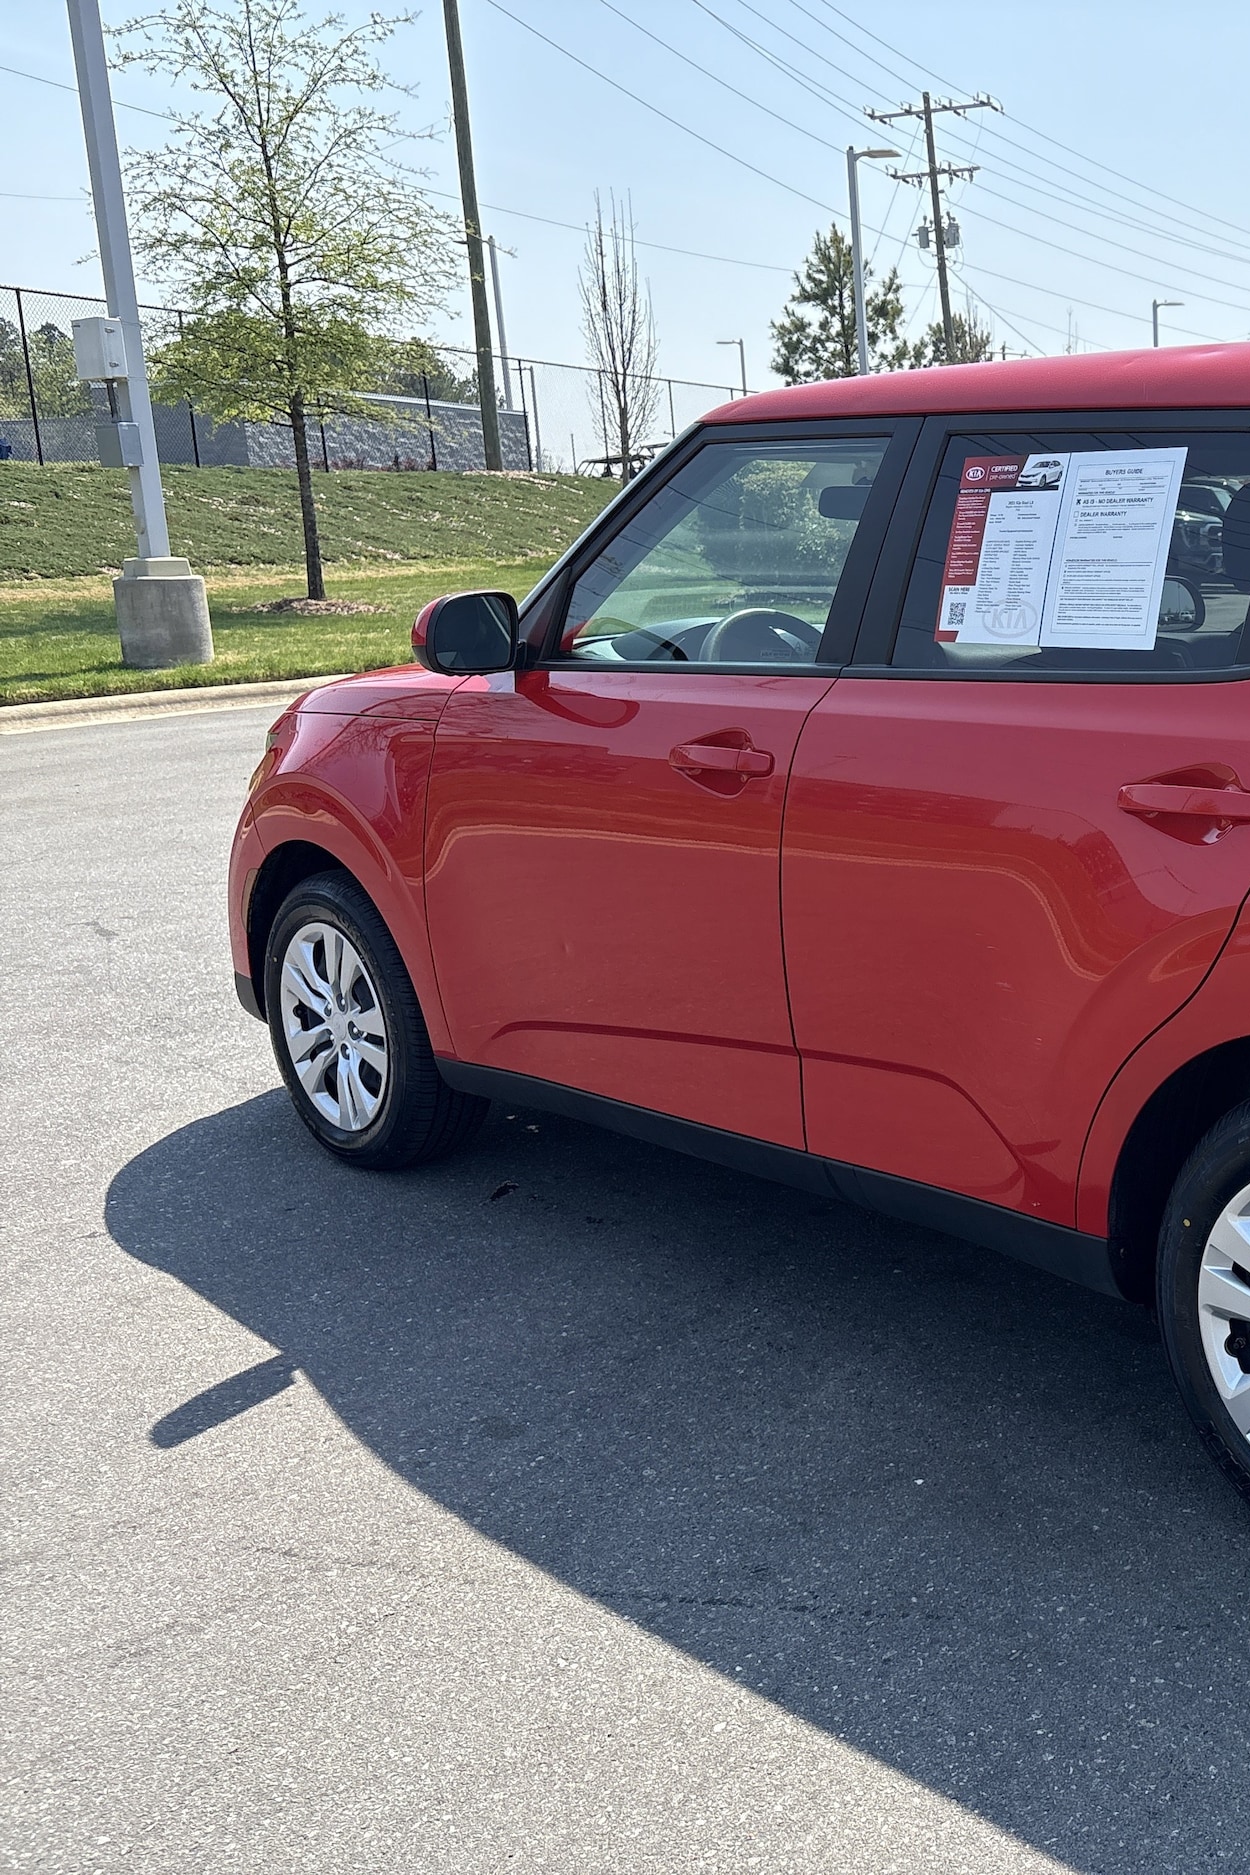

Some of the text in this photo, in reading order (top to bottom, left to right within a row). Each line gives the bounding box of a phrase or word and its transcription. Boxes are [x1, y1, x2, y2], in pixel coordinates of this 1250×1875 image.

[990, 464, 1019, 473] CERTIFIED
[1105, 468, 1126, 476] BUYERS
[991, 608, 1027, 629] KIA
